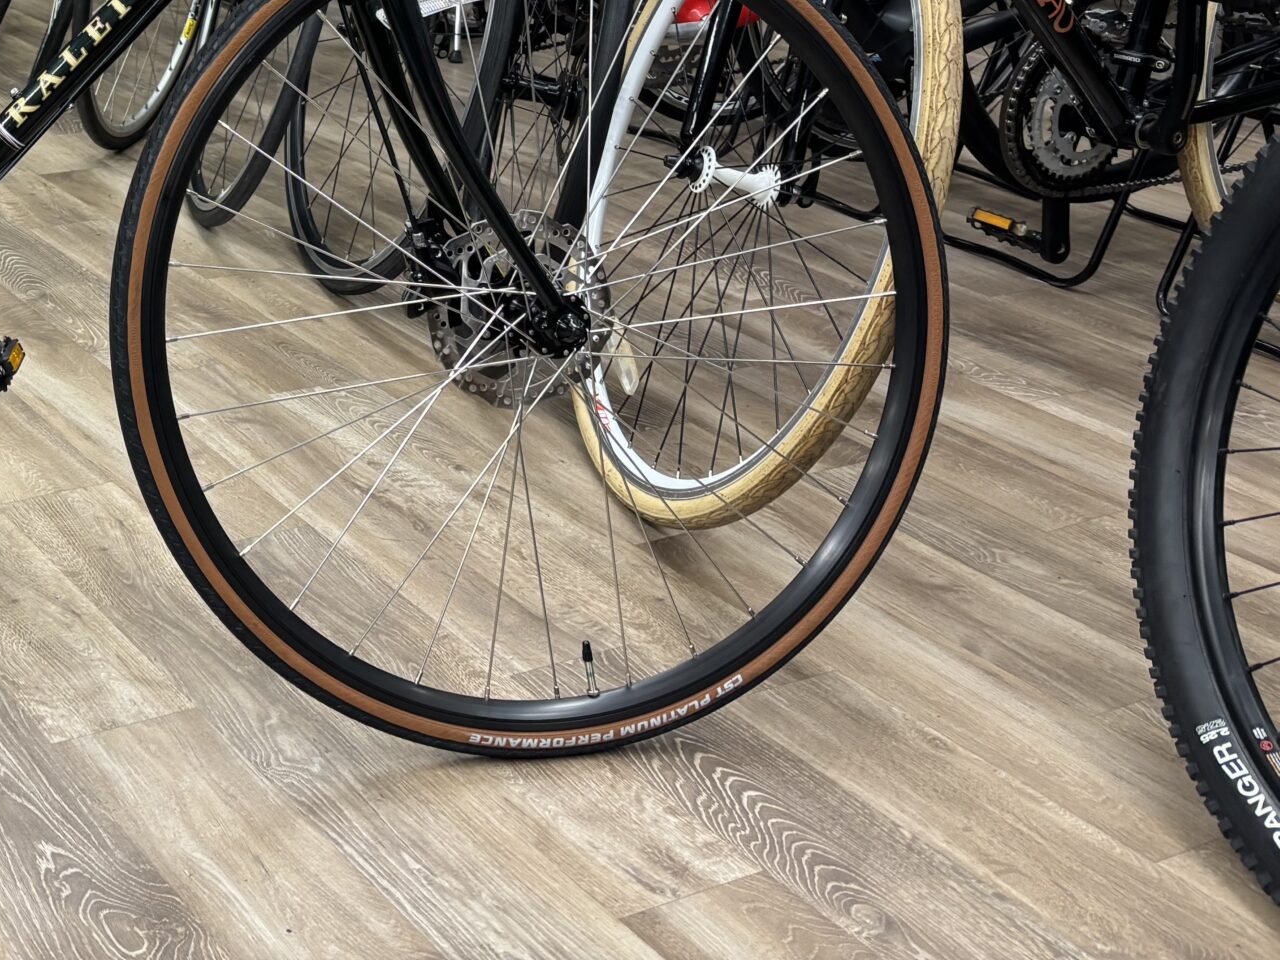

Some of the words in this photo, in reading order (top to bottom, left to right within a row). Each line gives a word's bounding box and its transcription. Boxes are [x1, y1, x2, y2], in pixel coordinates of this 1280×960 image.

[715, 673, 744, 696] CST
[619, 694, 714, 737] PLATINUM
[468, 727, 615, 749] PERFORMANCE
